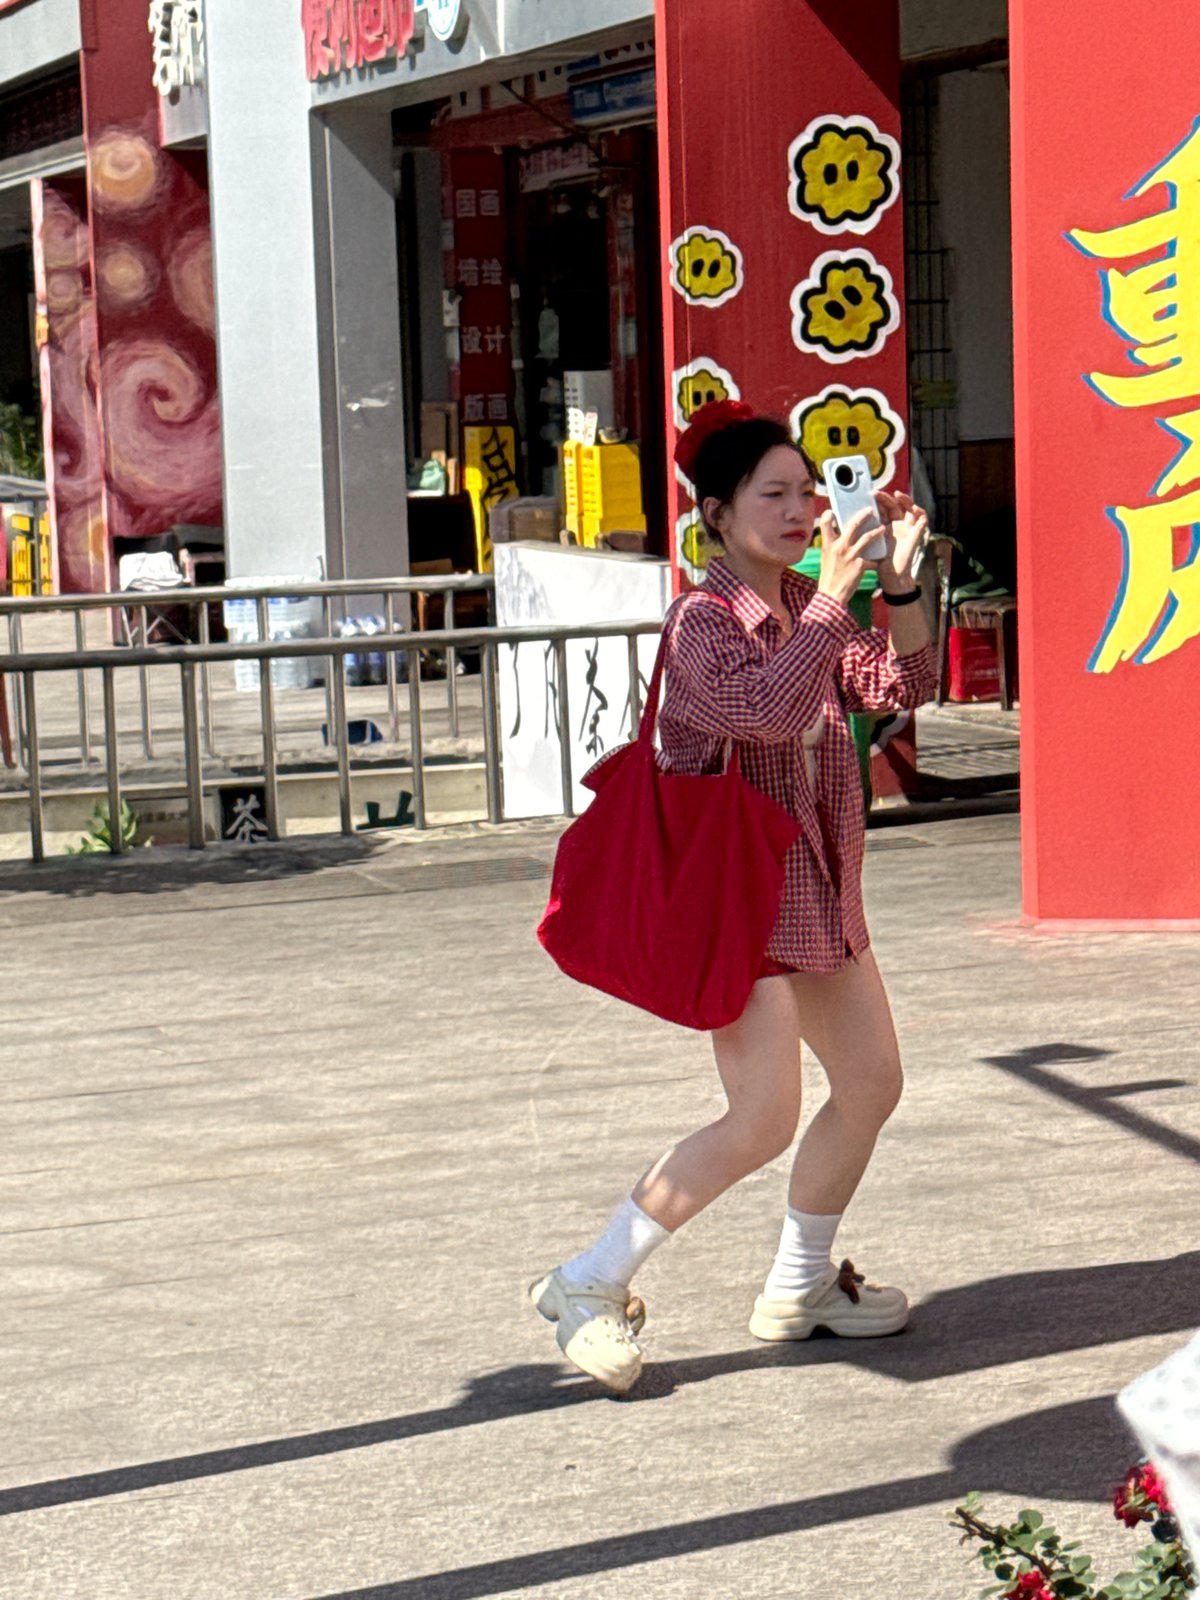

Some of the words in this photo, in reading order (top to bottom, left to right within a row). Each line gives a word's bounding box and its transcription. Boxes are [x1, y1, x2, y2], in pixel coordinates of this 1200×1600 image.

[456, 188, 500, 217] 国画
[458, 257, 502, 287] 墙绘
[461, 325, 506, 354] 设计
